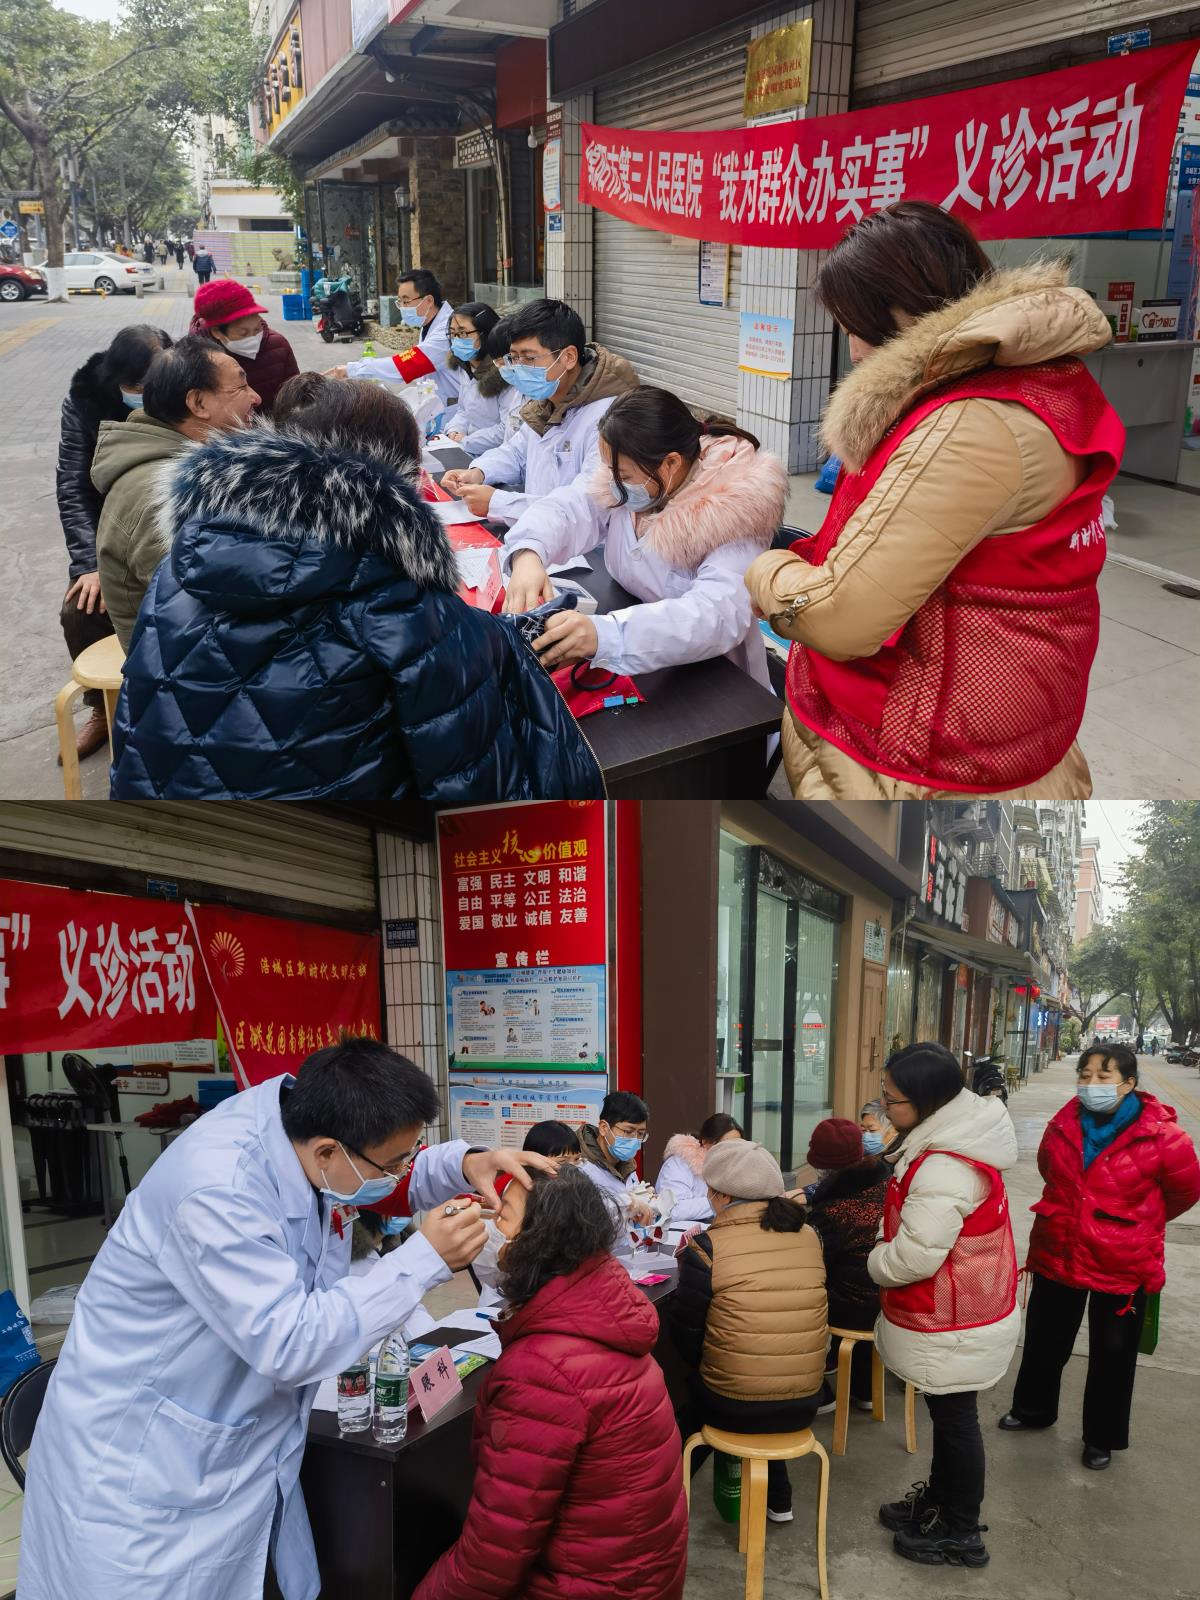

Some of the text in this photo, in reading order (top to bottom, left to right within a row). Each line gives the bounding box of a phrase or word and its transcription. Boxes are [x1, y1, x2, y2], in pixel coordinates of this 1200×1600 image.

[585, 140, 704, 219] 绵阳市第三人民医院
[712, 125, 930, 226] “我为群众办实事”
[940, 82, 1144, 212] 义诊活动
[457, 866, 587, 892] 富强 民主 文明 和谐
[458, 887, 587, 912] 自由 平等 公正 法治
[458, 907, 588, 931] 爱国 敬业 诚信 友善
[57, 919, 196, 1021] 义诊活动
[495, 950, 550, 968] 宣传栏
[420, 1357, 450, 1393] 眼科
